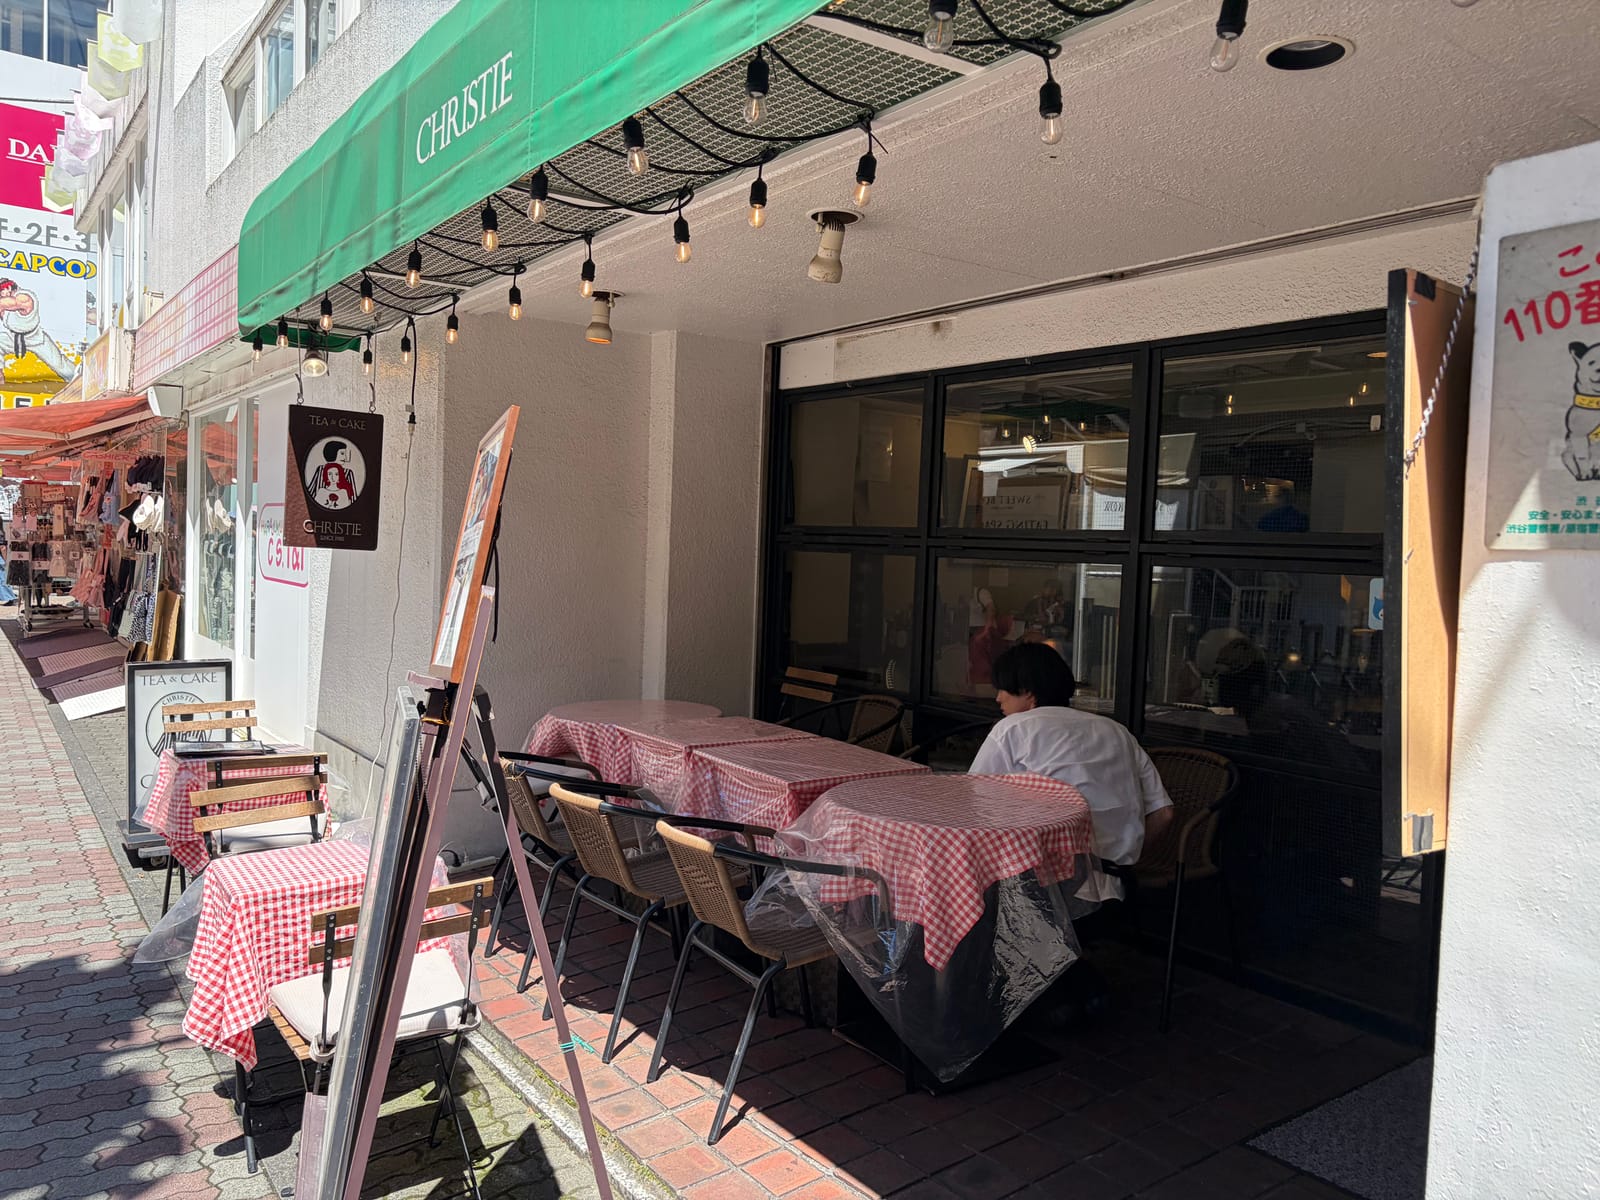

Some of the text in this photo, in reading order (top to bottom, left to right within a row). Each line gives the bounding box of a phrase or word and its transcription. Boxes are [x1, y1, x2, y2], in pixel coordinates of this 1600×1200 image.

[416, 51, 513, 164] CHRISTIE
[8, 138, 57, 164] DA
[1558, 245, 1600, 277] こ
[309, 415, 329, 426] TEA
[338, 418, 367, 430] CAKE
[303, 519, 362, 536] CHRISTIE
[141, 673, 167, 686] TEA
[181, 671, 217, 684] CAKE
